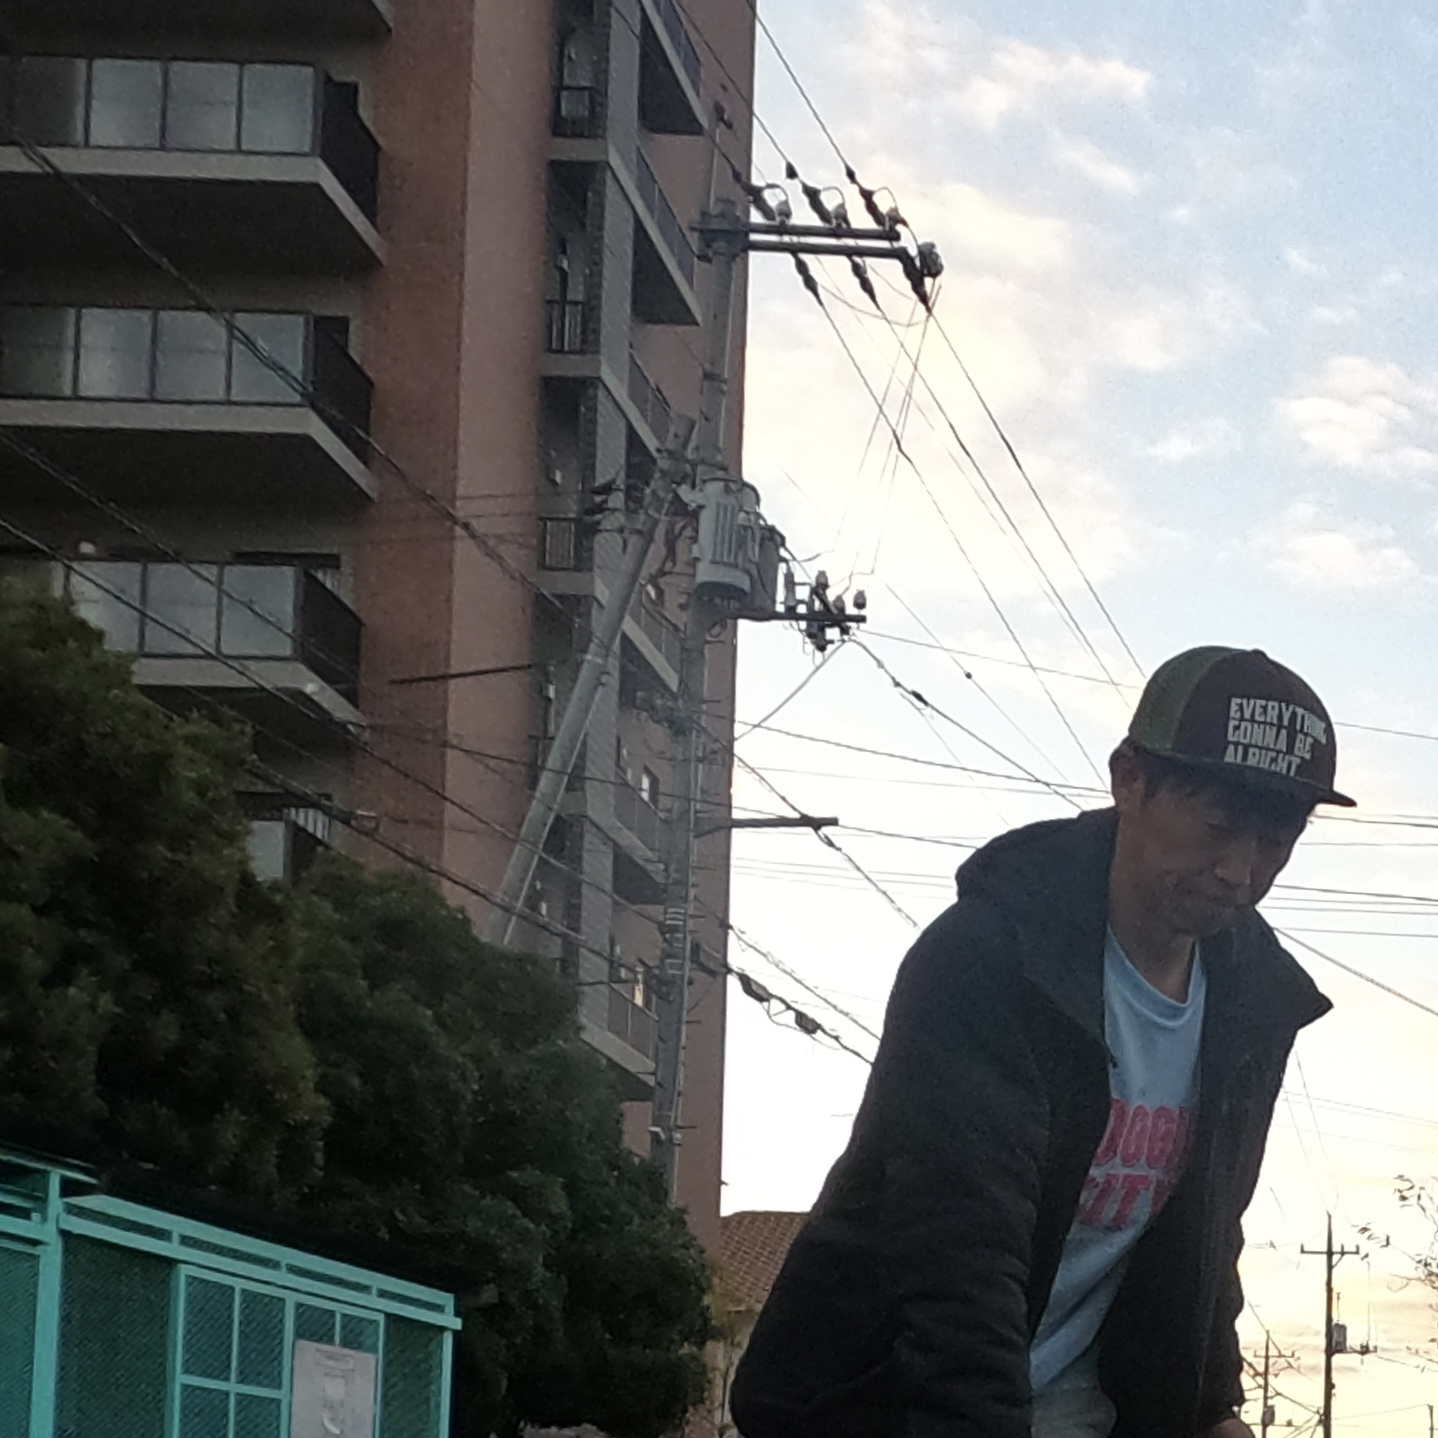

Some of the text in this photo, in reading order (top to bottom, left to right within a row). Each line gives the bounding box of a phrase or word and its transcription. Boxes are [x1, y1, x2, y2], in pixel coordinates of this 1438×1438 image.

[1227, 719, 1314, 760] GONNA BE
[1229, 697, 1327, 745] EVERYTH
